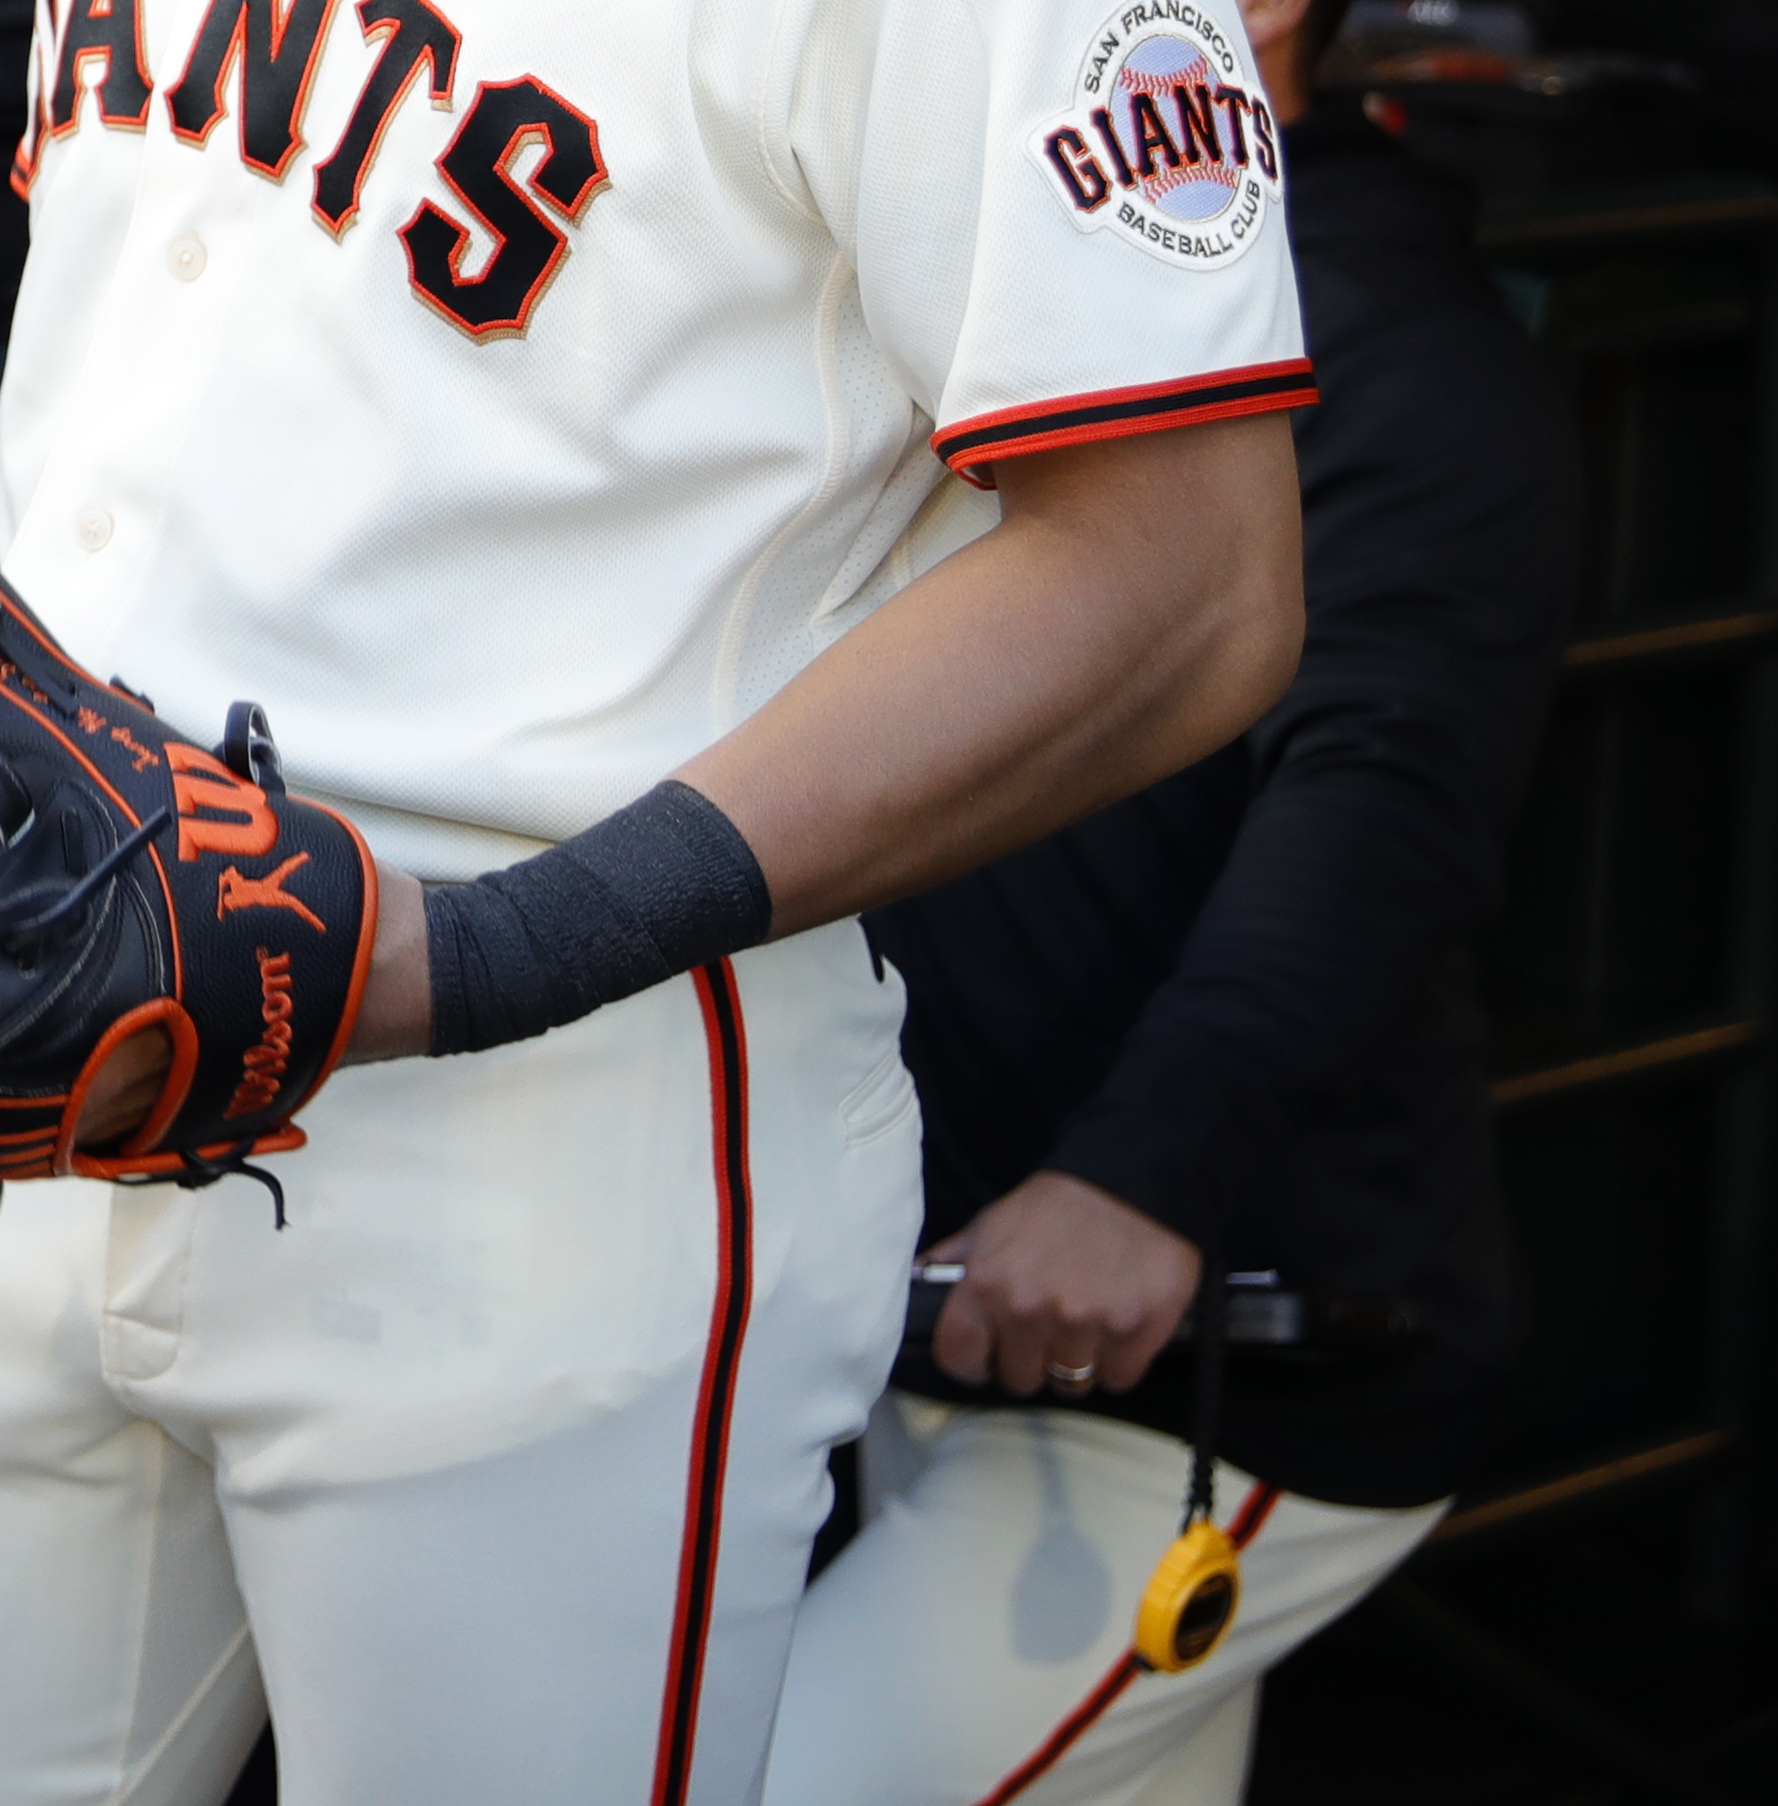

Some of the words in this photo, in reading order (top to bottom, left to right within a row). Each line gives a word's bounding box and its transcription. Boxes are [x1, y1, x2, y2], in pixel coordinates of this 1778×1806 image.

[1085, 32, 1120, 94] SAN
[1121, 0, 1234, 74] FRANCISCO
[1044, 80, 1277, 213] GIANTS
[1117, 201, 1233, 258] BASEBALL
[1231, 179, 1261, 239] CLUB
[223, 952, 294, 1121] Wilson
